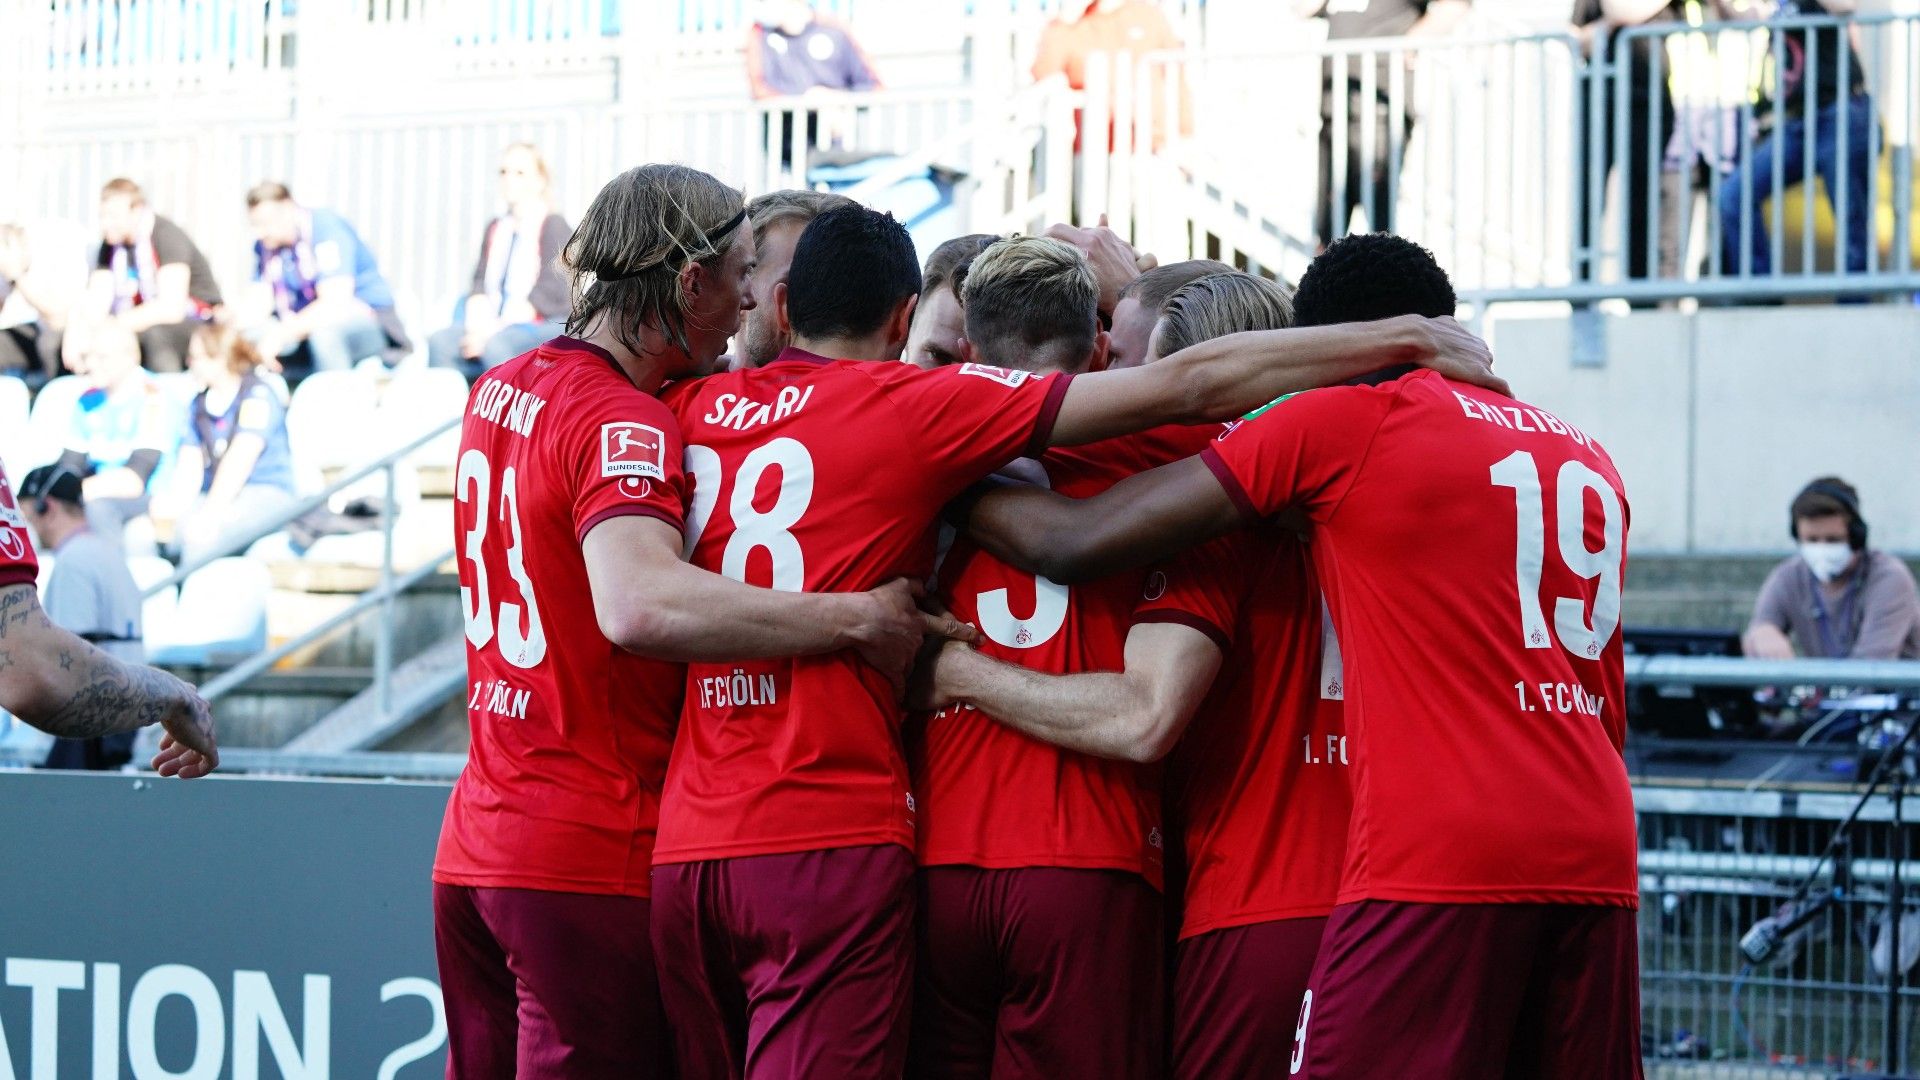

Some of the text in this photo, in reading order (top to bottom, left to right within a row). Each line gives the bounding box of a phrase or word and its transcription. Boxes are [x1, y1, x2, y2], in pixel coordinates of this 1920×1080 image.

[607, 464, 660, 475] BUNDESLIGA
[454, 449, 547, 669] 33
[1489, 450, 1623, 660] 19
[1303, 734, 1320, 763] 1.
[0, 957, 331, 1080] TION
